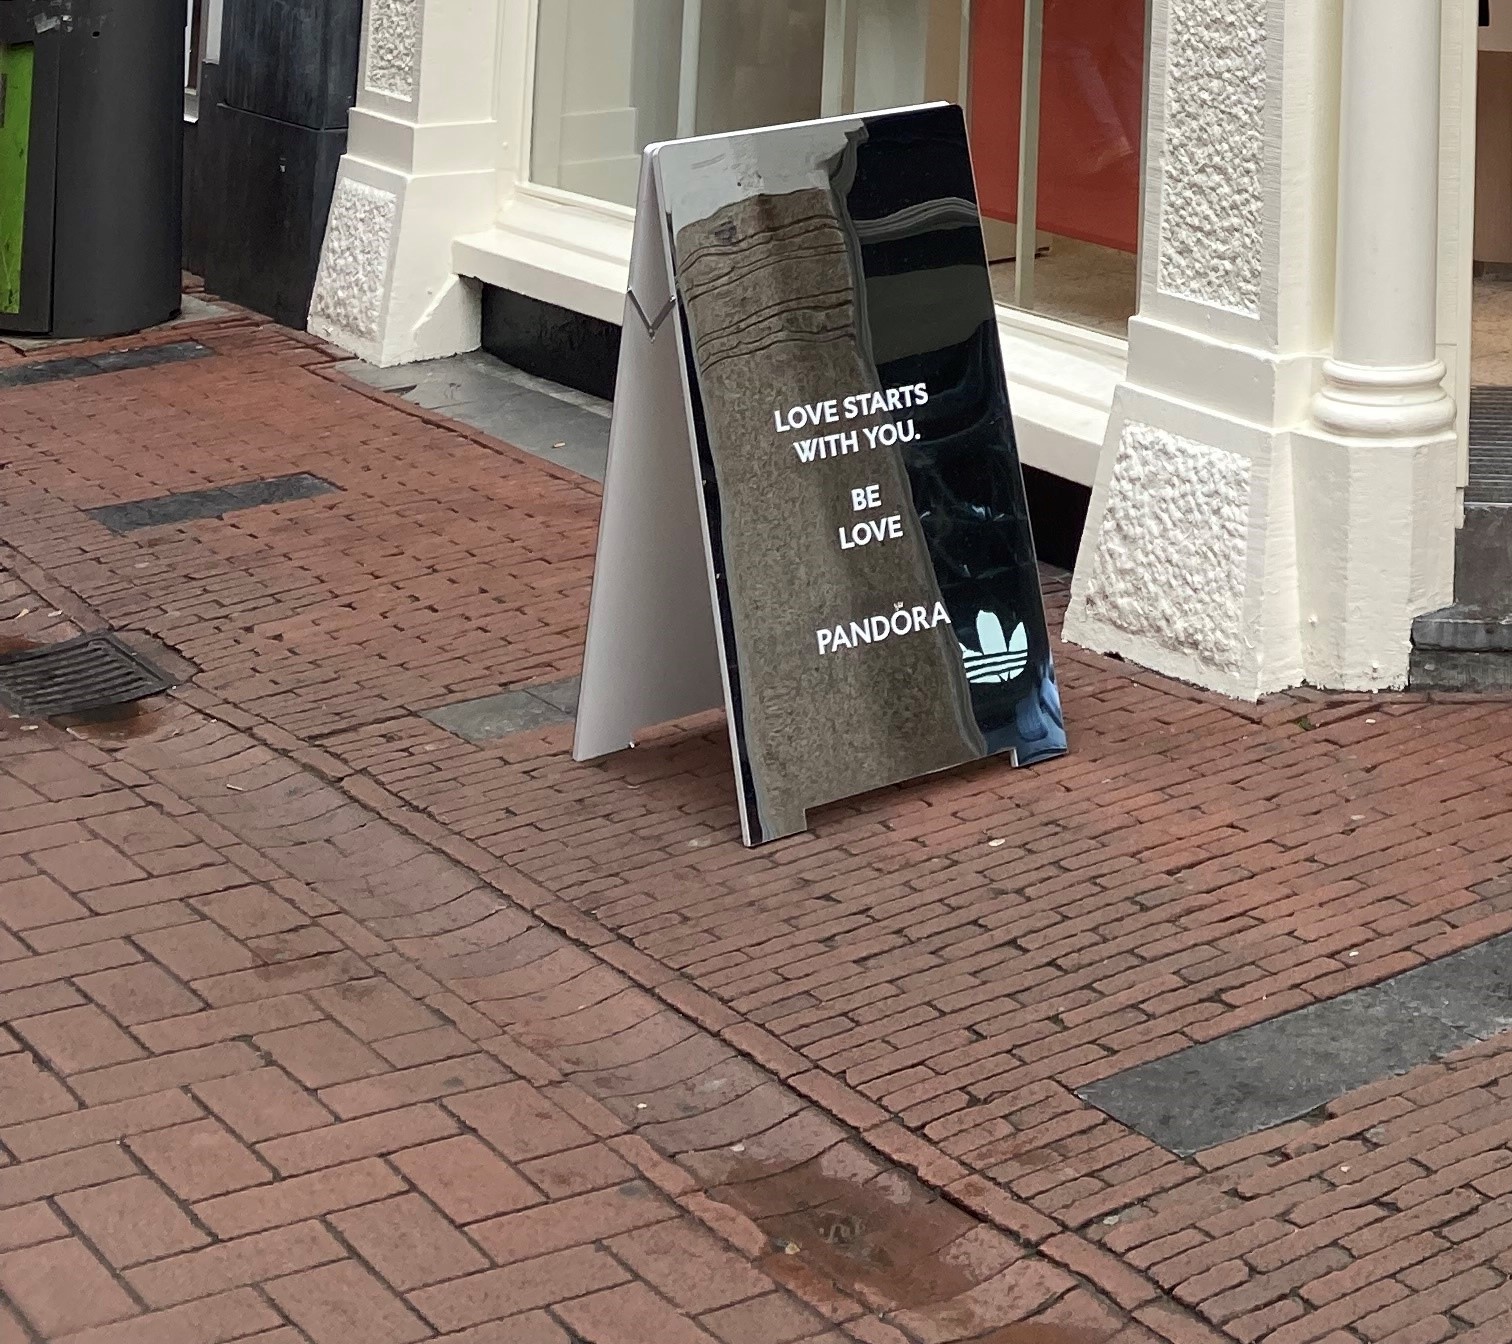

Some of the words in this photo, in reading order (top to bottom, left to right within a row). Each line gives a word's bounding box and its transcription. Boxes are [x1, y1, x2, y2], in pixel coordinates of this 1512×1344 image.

[774, 399, 840, 433] LOVE
[842, 382, 929, 419] STARTS
[793, 430, 860, 463] WITH
[862, 418, 921, 450] YOU.
[851, 484, 882, 511] BE
[838, 514, 904, 550] LOVE
[816, 601, 952, 655] PANDORA
